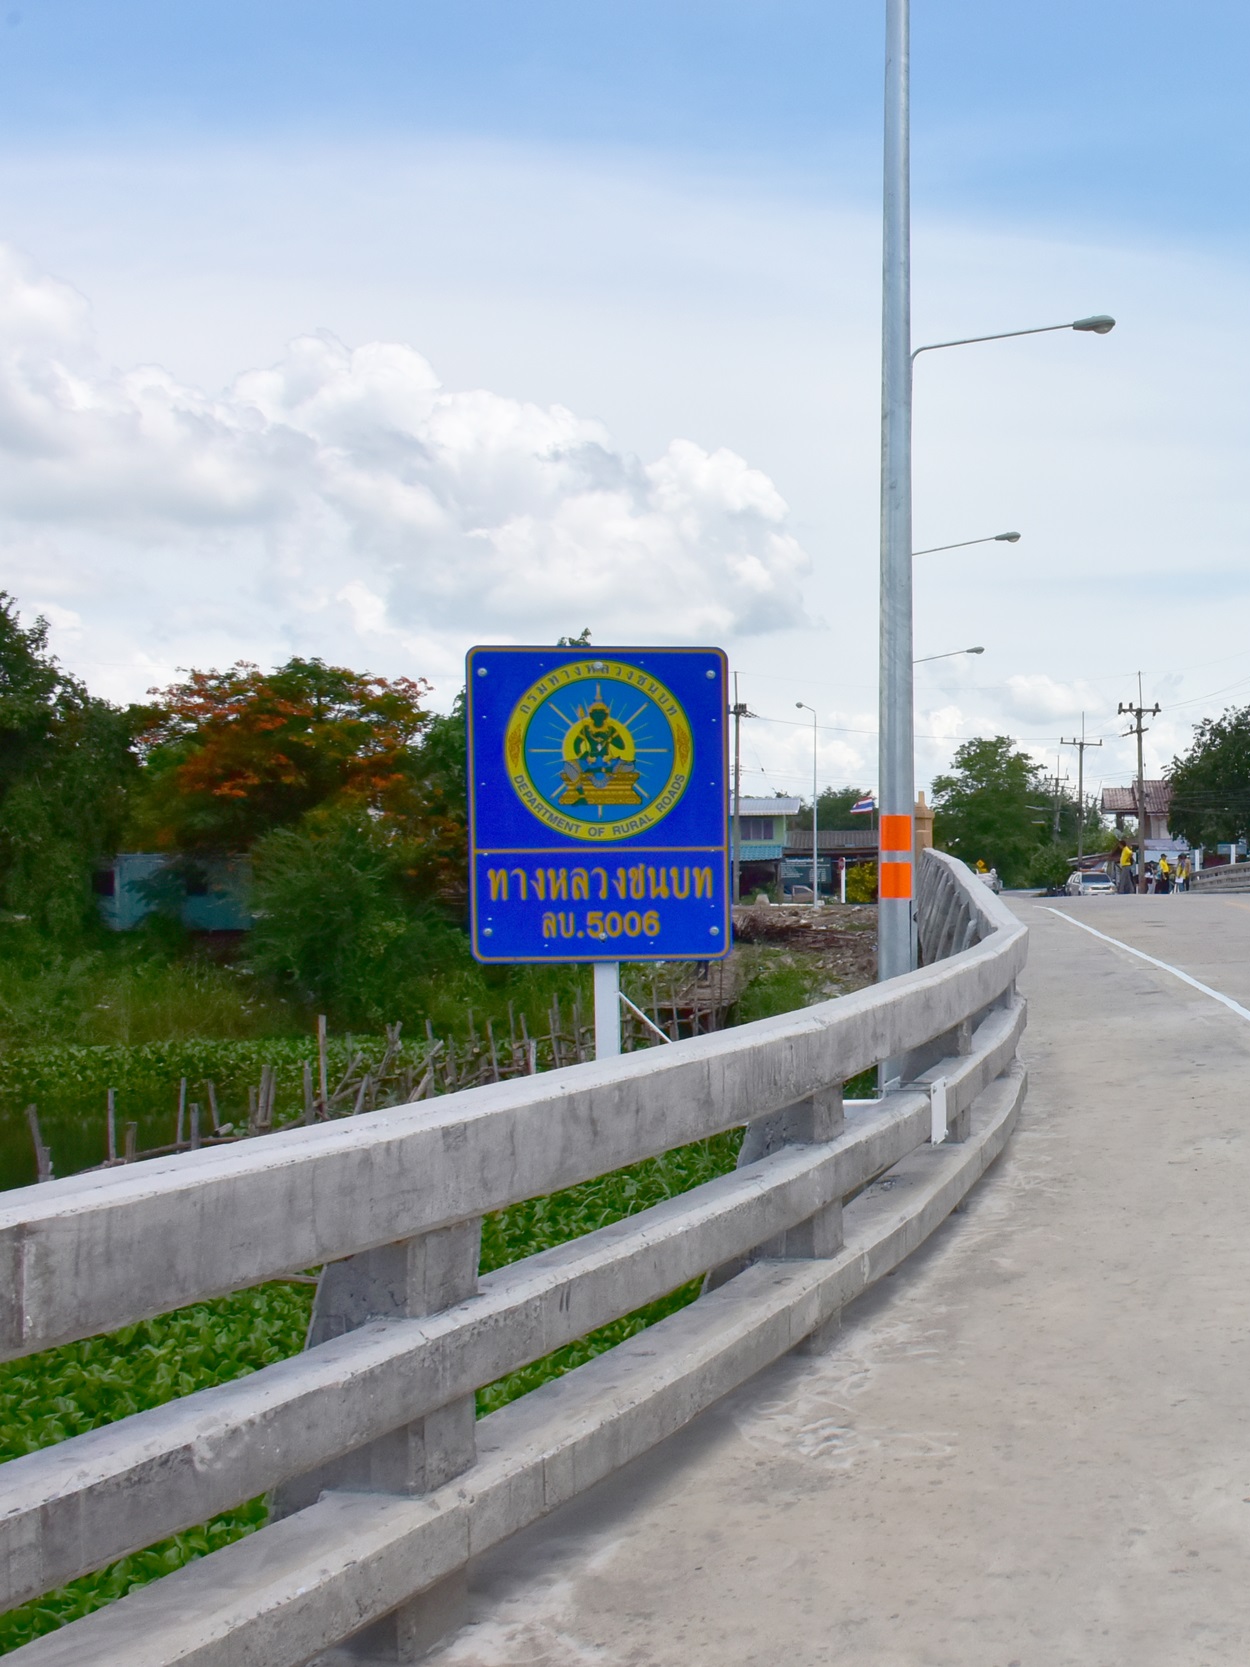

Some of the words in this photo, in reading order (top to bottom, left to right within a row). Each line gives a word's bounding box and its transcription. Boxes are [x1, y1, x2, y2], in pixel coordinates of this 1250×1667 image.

[519, 663, 678, 717] กรมทางหลวงชนบท
[514, 774, 582, 835] DEPARTMENT
[587, 826, 605, 837] OF
[612, 814, 655, 836] RURAL
[656, 773, 686, 814] ROADS
[488, 863, 713, 901] ทางหลวงชนบท
